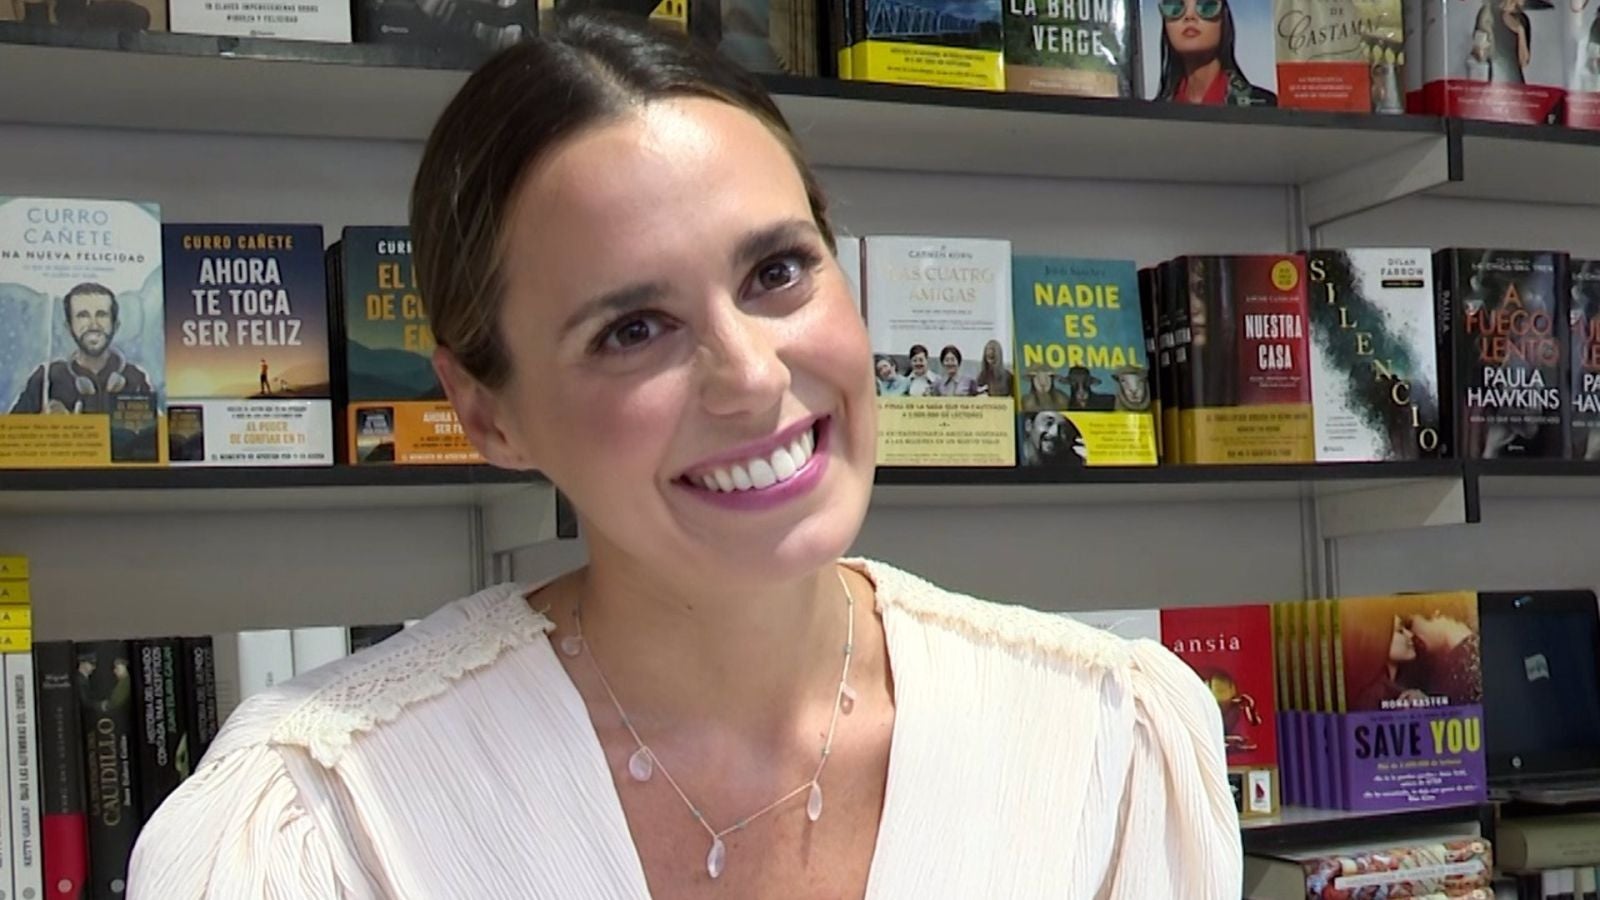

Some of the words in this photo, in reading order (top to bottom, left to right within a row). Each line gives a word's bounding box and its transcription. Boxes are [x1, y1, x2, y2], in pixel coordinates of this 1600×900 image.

[1010, 0, 1037, 16] LA
[1330, 7, 1344, 16] DE
[27, 208, 109, 226] CURRO
[24, 226, 112, 247] CAÑETE
[183, 235, 231, 249] CURRO
[238, 233, 293, 249] CAÑETE
[2, 250, 20, 260] NA
[26, 251, 71, 261] NUEVA
[76, 252, 145, 264] FELICIDAD
[1387, 258, 1416, 267] DYLAN
[200, 257, 281, 285] AHORA
[378, 262, 405, 289] EL
[924, 267, 993, 284] CUATRO
[1380, 267, 1424, 277] FARROW
[192, 289, 222, 315] TE
[228, 289, 290, 315] TOCA
[366, 294, 396, 320] DE
[910, 288, 977, 304] AMIGAS
[1034, 282, 1120, 310] NADIE
[1503, 283, 1523, 309] A
[182, 319, 230, 347] SER
[237, 319, 301, 346] FELIZ
[1064, 313, 1098, 339] ES
[1244, 313, 1303, 340] NUESTRA
[1465, 308, 1552, 336] FUEGO
[1023, 343, 1144, 369] NORMAL
[1258, 344, 1293, 371] CASA
[1310, 258, 1439, 453] SILENCIO
[1481, 338, 1560, 365] LENTO
[1483, 367, 1545, 388] PAULA
[1466, 387, 1560, 409] HAWKINS
[1174, 634, 1241, 653] ansia
[1381, 699, 1411, 709] MONA
[1412, 696, 1449, 708] KASTEN
[1354, 722, 1422, 759] SAVE
[1429, 716, 1481, 754] YOU
[97, 717, 121, 827] CAUDILLO
